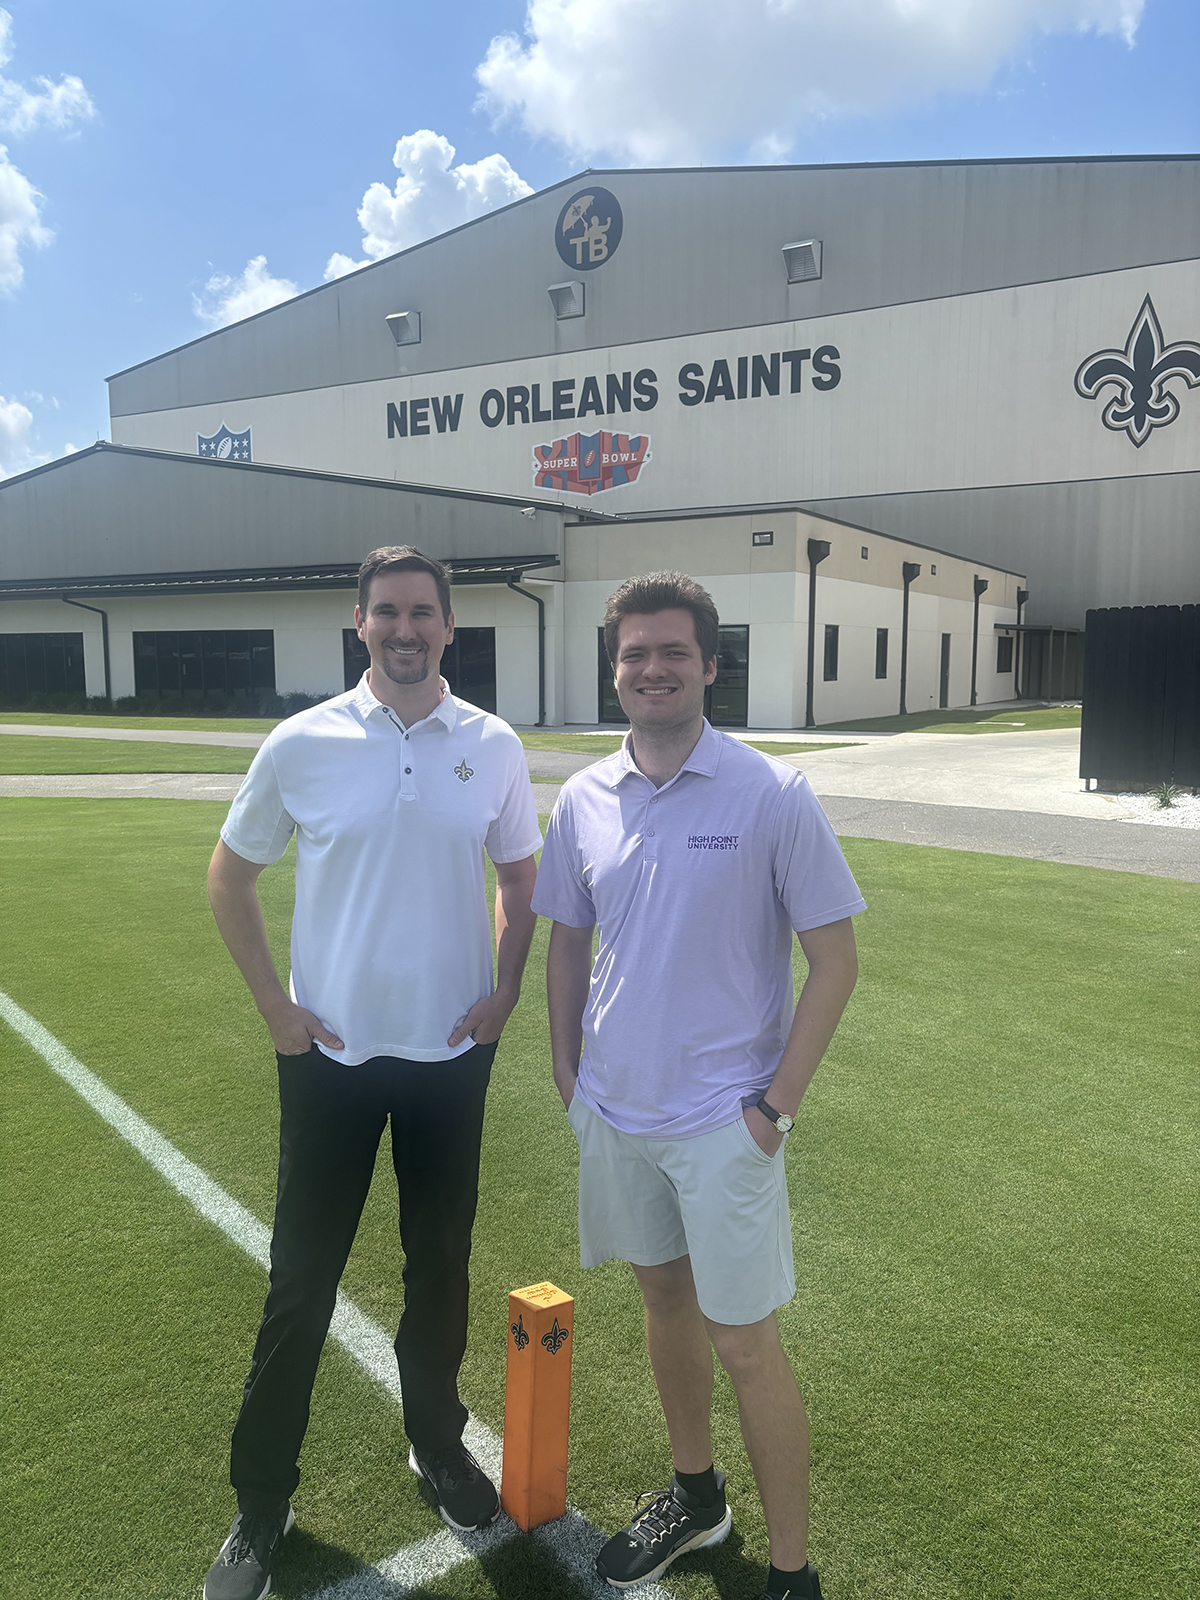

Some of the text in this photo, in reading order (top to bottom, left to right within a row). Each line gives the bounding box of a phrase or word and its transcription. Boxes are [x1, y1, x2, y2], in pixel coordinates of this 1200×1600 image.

[569, 233, 609, 265] TB
[386, 344, 842, 439] NEW ORLEANS SAINTS
[543, 453, 638, 469] SUPER BOWL
[688, 835, 739, 844] HIGH POINT
